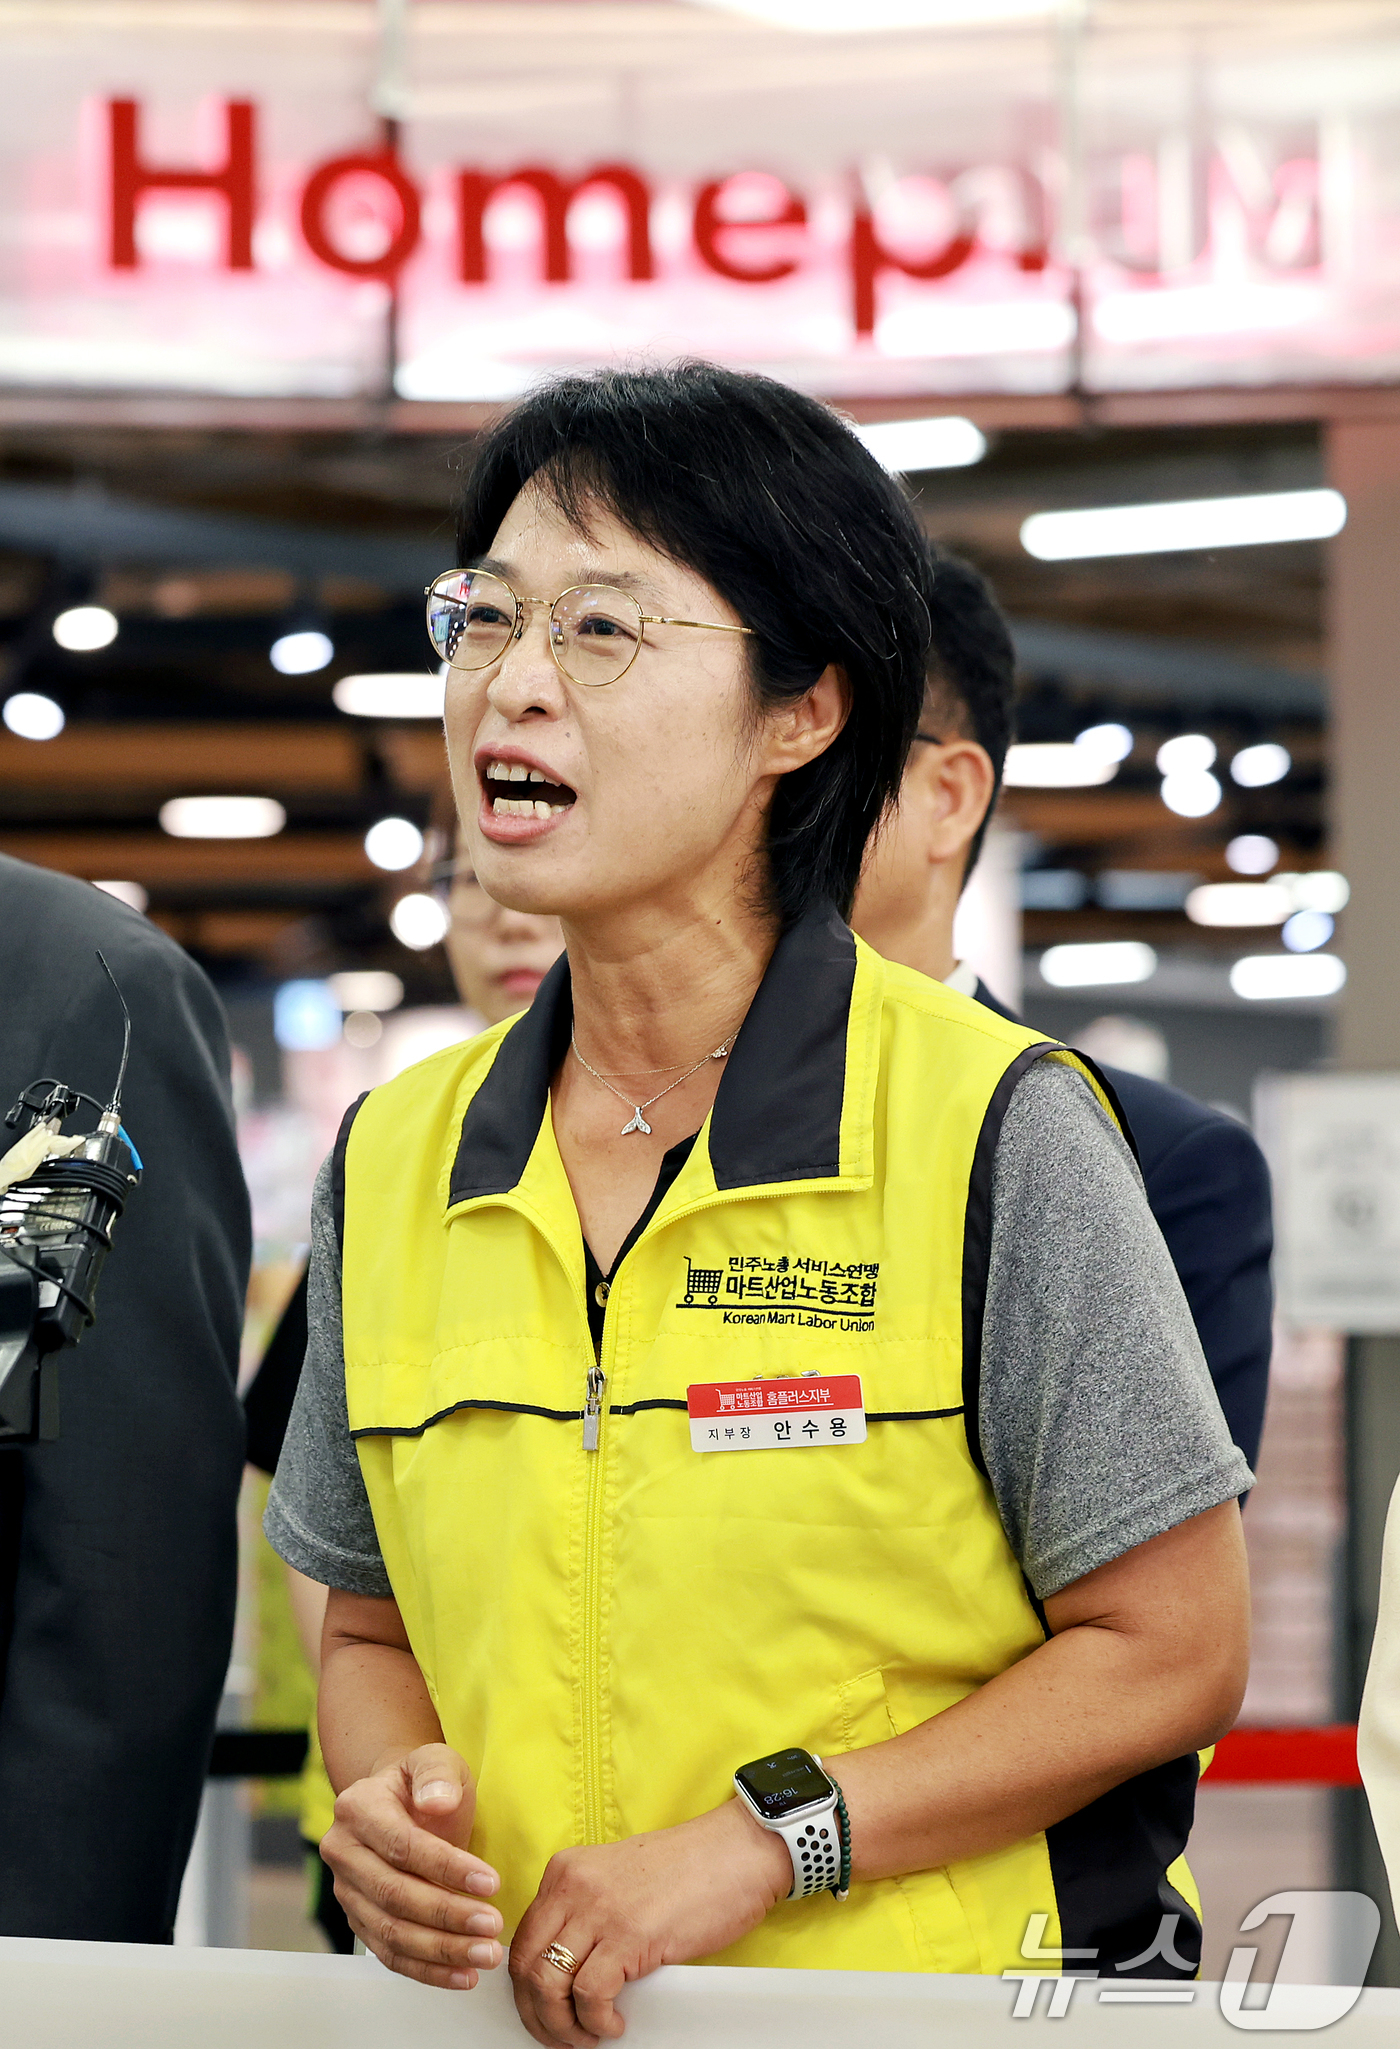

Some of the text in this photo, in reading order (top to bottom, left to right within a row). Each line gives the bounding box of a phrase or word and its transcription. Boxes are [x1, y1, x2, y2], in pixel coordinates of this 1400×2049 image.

[728, 1256, 880, 1279] 민주노총 서비스연맹
[726, 1274, 877, 1307] 마트산업노동조합
[723, 1311, 875, 1333] Korean Mart Labor Union
[766, 1388, 831, 1406] 홈플러스지부
[764, 1787, 798, 1805] 16:28
